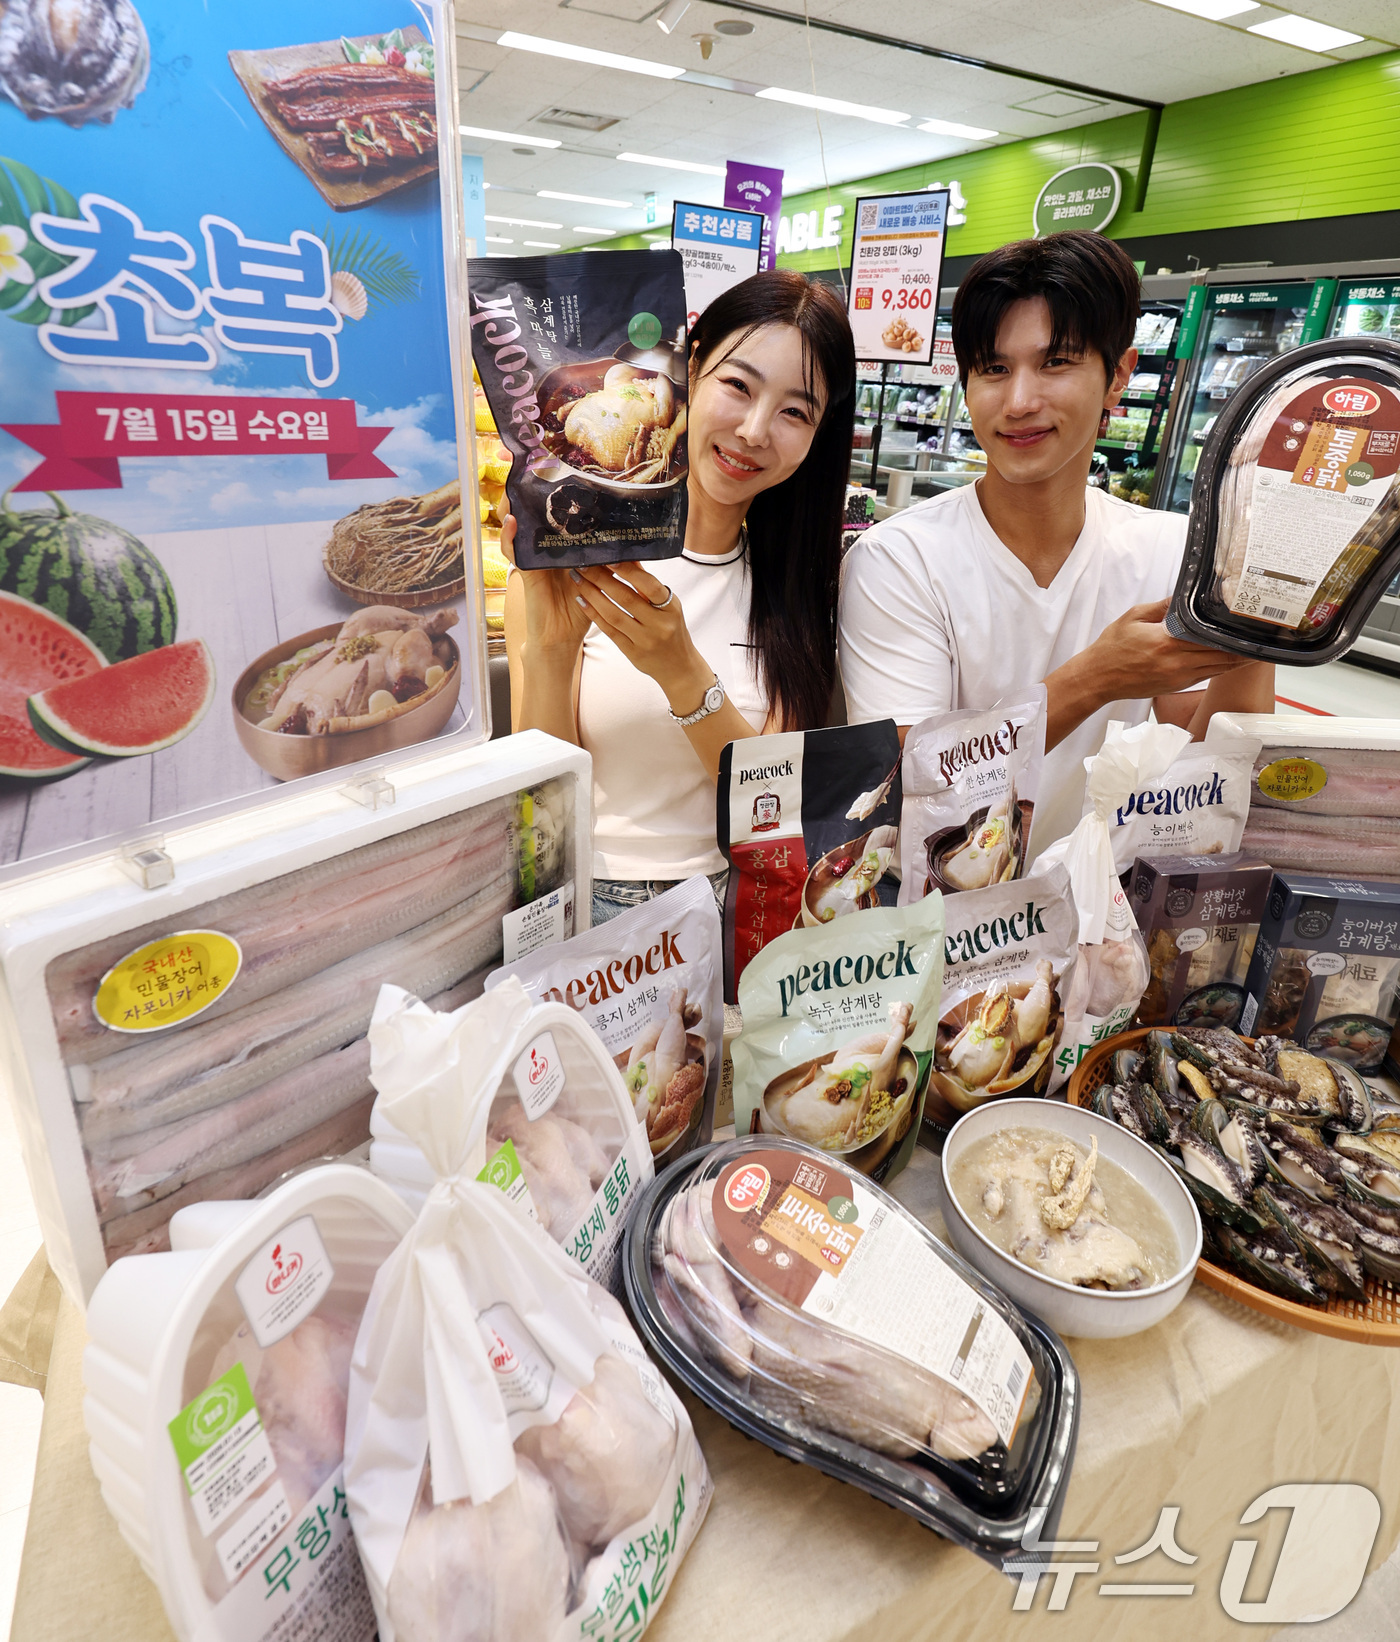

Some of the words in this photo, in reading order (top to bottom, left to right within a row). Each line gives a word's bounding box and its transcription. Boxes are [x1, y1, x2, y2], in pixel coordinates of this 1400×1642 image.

[1043, 193, 1066, 207] 맛있는
[1066, 190, 1084, 203] 과일,
[1086, 185, 1111, 200] 채소만
[879, 216, 900, 228] 새로운
[901, 215, 917, 227] 배송
[918, 214, 941, 226] 서비스
[883, 204, 914, 216] 이마트앱의
[683, 211, 753, 241] 추천상품
[860, 246, 881, 258] 친환경
[882, 246, 898, 257] 양파
[899, 244, 922, 258] (3kg)
[30, 192, 343, 388] 초복
[902, 274, 930, 285] 10,400
[881, 288, 932, 311] 9,360
[1215, 293, 1244, 304] 냉동채소
[1348, 287, 1386, 300] 냉동채소
[539, 297, 558, 343] 삼계탕
[932, 364, 956, 376] 6,980
[470, 293, 560, 473] peacock
[1334, 391, 1369, 411] 하림
[96, 407, 159, 442] 7월
[166, 409, 239, 442] 15일
[248, 410, 330, 442] 수요일
[1315, 428, 1357, 489] 토종닭
[938, 719, 1024, 788] peacock
[739, 760, 794, 785] peacock
[976, 766, 1007, 786] 삼계탕
[1276, 774, 1309, 784] 민물장어
[1283, 765, 1307, 774] 국내산
[1116, 772, 1227, 827] peacock
[1266, 783, 1299, 793] 자포니카
[1150, 820, 1194, 836] 능이백숙
[748, 846, 792, 870] 홍삼
[1203, 888, 1246, 904] 상황버섯
[1200, 902, 1241, 921] 삼계탕
[944, 901, 1048, 966] eacock
[1341, 918, 1397, 935] 능이버섯
[1337, 932, 1391, 951] 삼계탕
[142, 946, 193, 974] 국내산
[136, 961, 203, 997] 민물장어
[777, 940, 918, 1016] peacock
[123, 985, 193, 1022] 자포니카
[196, 975, 222, 992] 어종
[590, 1006, 624, 1031] 룽지
[627, 986, 659, 1016] 삼계탕
[808, 1001, 835, 1020] 녹두
[839, 992, 882, 1014] 삼계탕
[603, 1156, 631, 1216] 통닭
[732, 1171, 764, 1201] 하림
[778, 1194, 856, 1255] 토종닭
